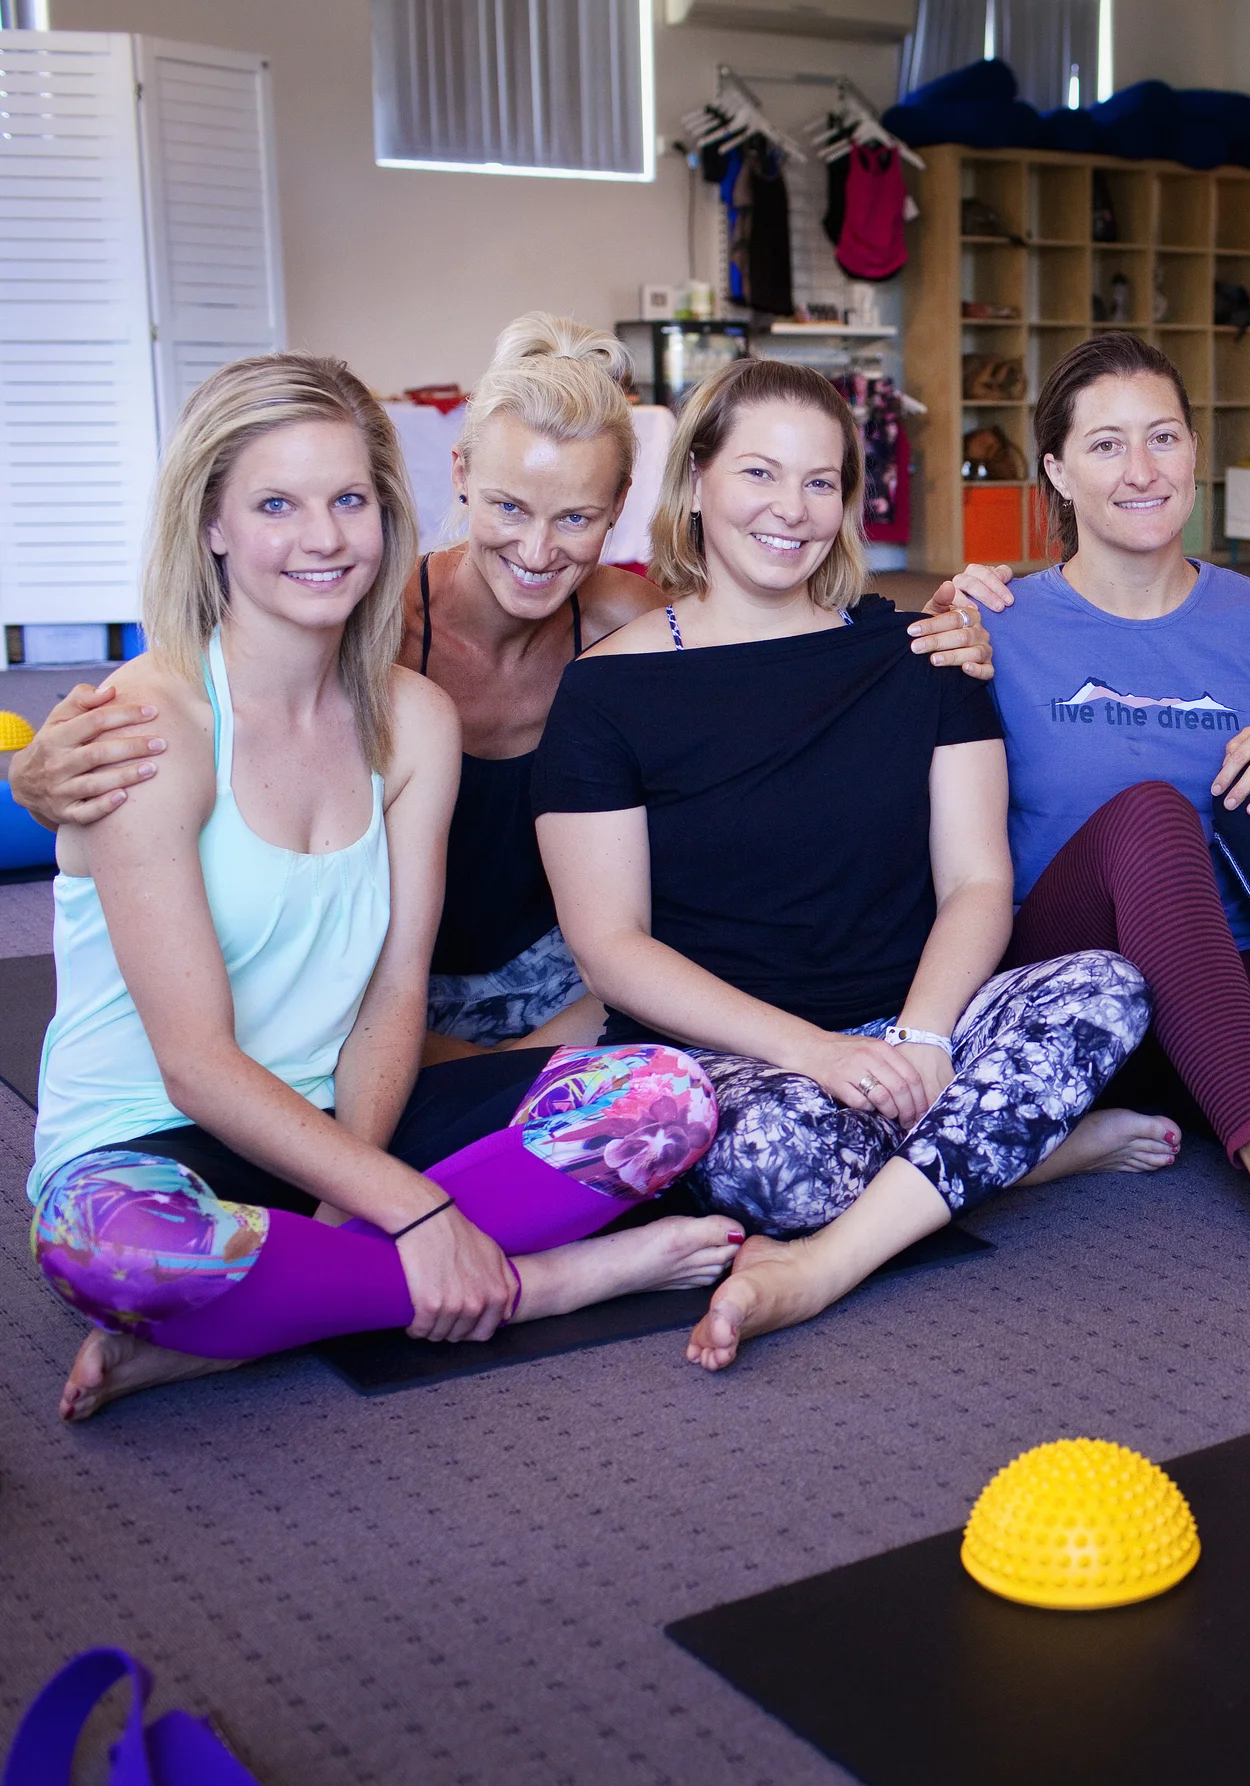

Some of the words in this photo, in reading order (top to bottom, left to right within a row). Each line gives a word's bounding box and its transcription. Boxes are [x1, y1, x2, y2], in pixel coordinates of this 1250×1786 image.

[1051, 698, 1094, 723] live
[1105, 701, 1147, 726] the
[1157, 705, 1240, 731] dream
